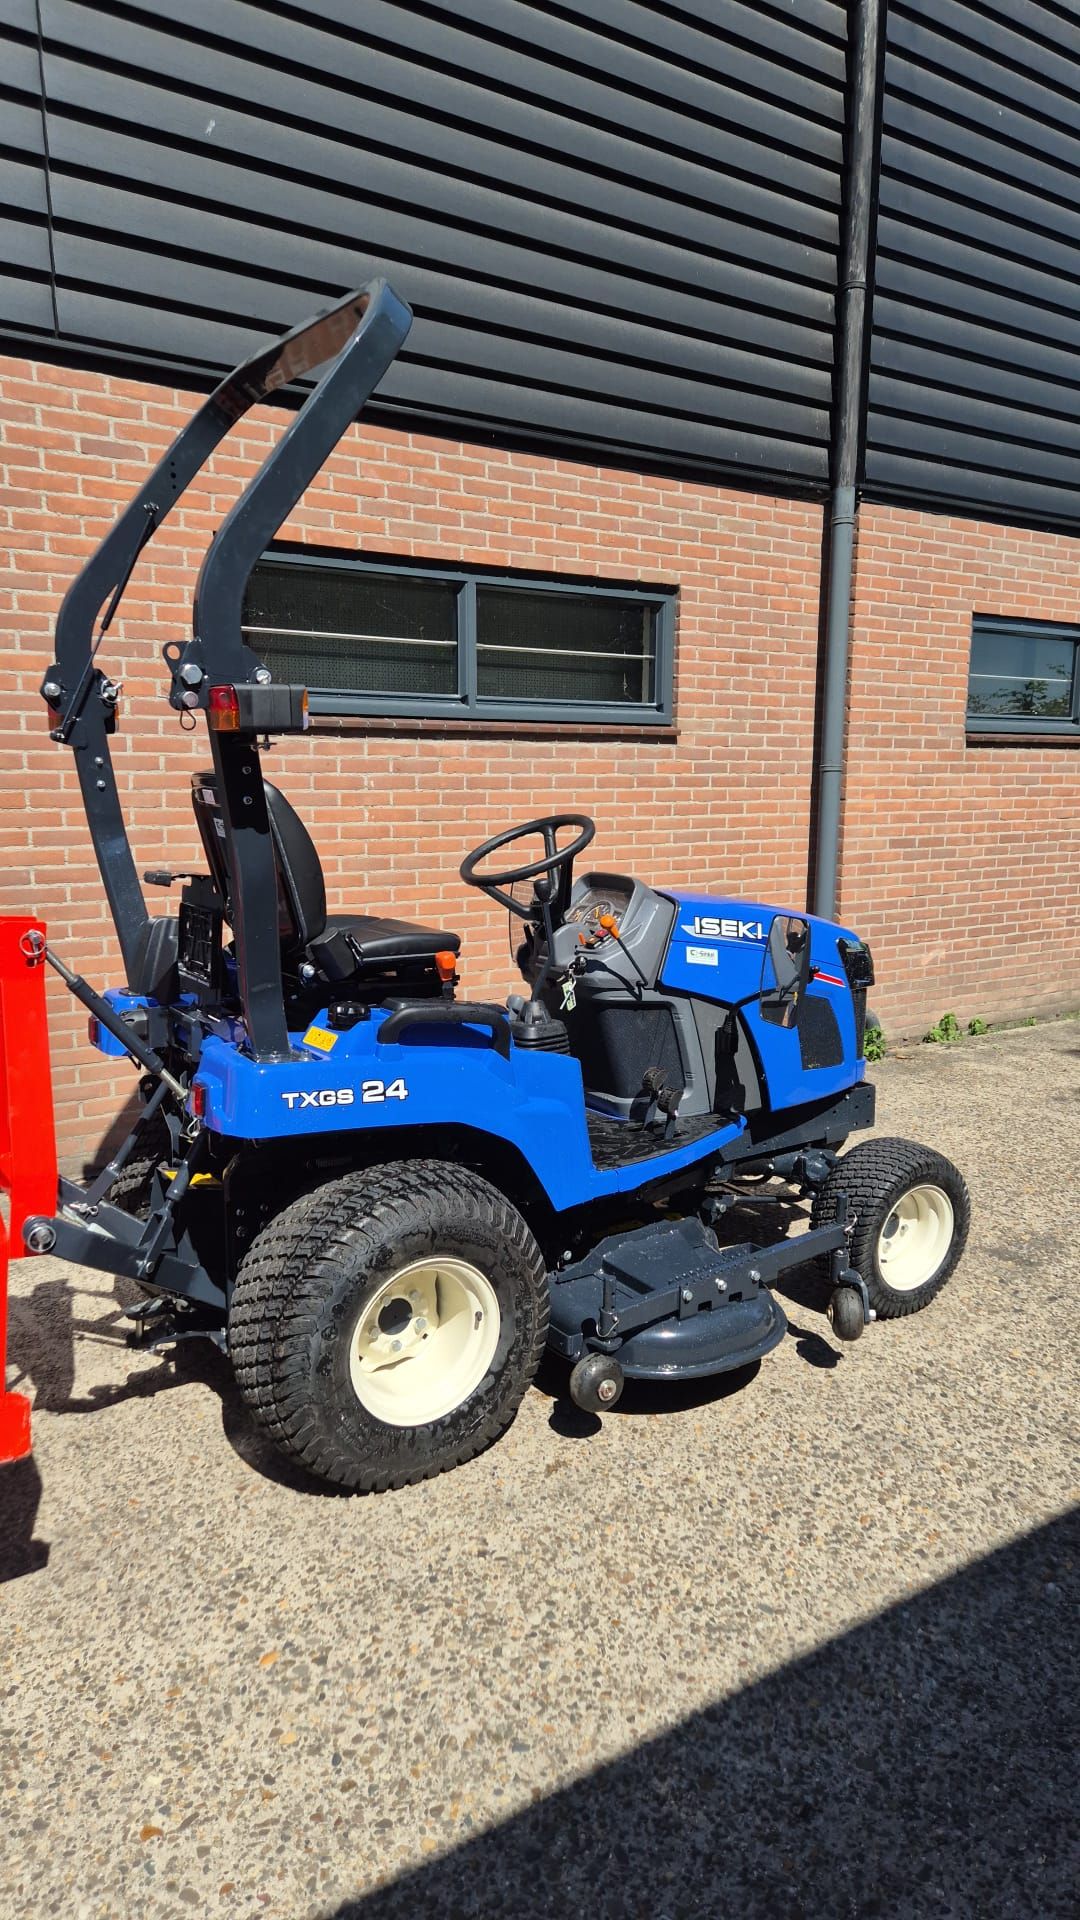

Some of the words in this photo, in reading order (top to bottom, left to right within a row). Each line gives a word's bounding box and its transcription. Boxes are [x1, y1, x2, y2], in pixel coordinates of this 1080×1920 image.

[694, 916, 763, 940] ISEKI
[282, 1088, 354, 1109] TXGS
[361, 1078, 409, 1104] 24
